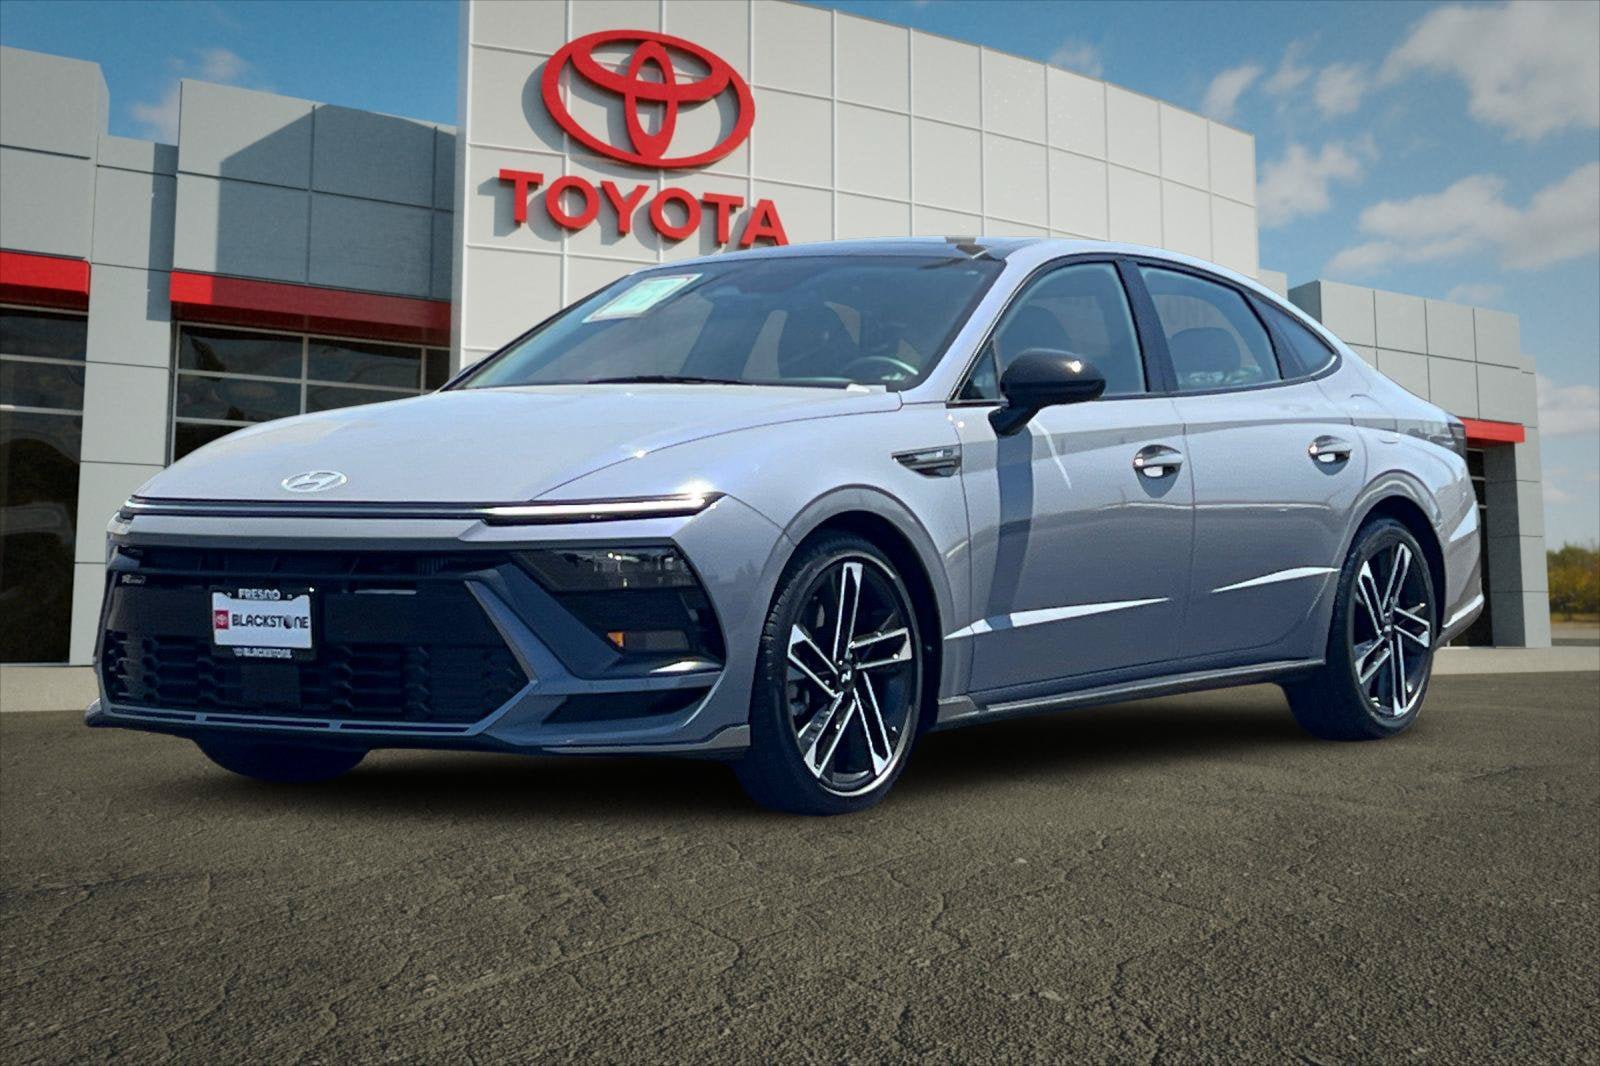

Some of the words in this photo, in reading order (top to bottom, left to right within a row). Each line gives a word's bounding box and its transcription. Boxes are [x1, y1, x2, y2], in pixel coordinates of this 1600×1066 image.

[500, 168, 789, 246] TOYOTA
[238, 588, 281, 600] FRESNO
[231, 614, 309, 629] BLACKSTONE
